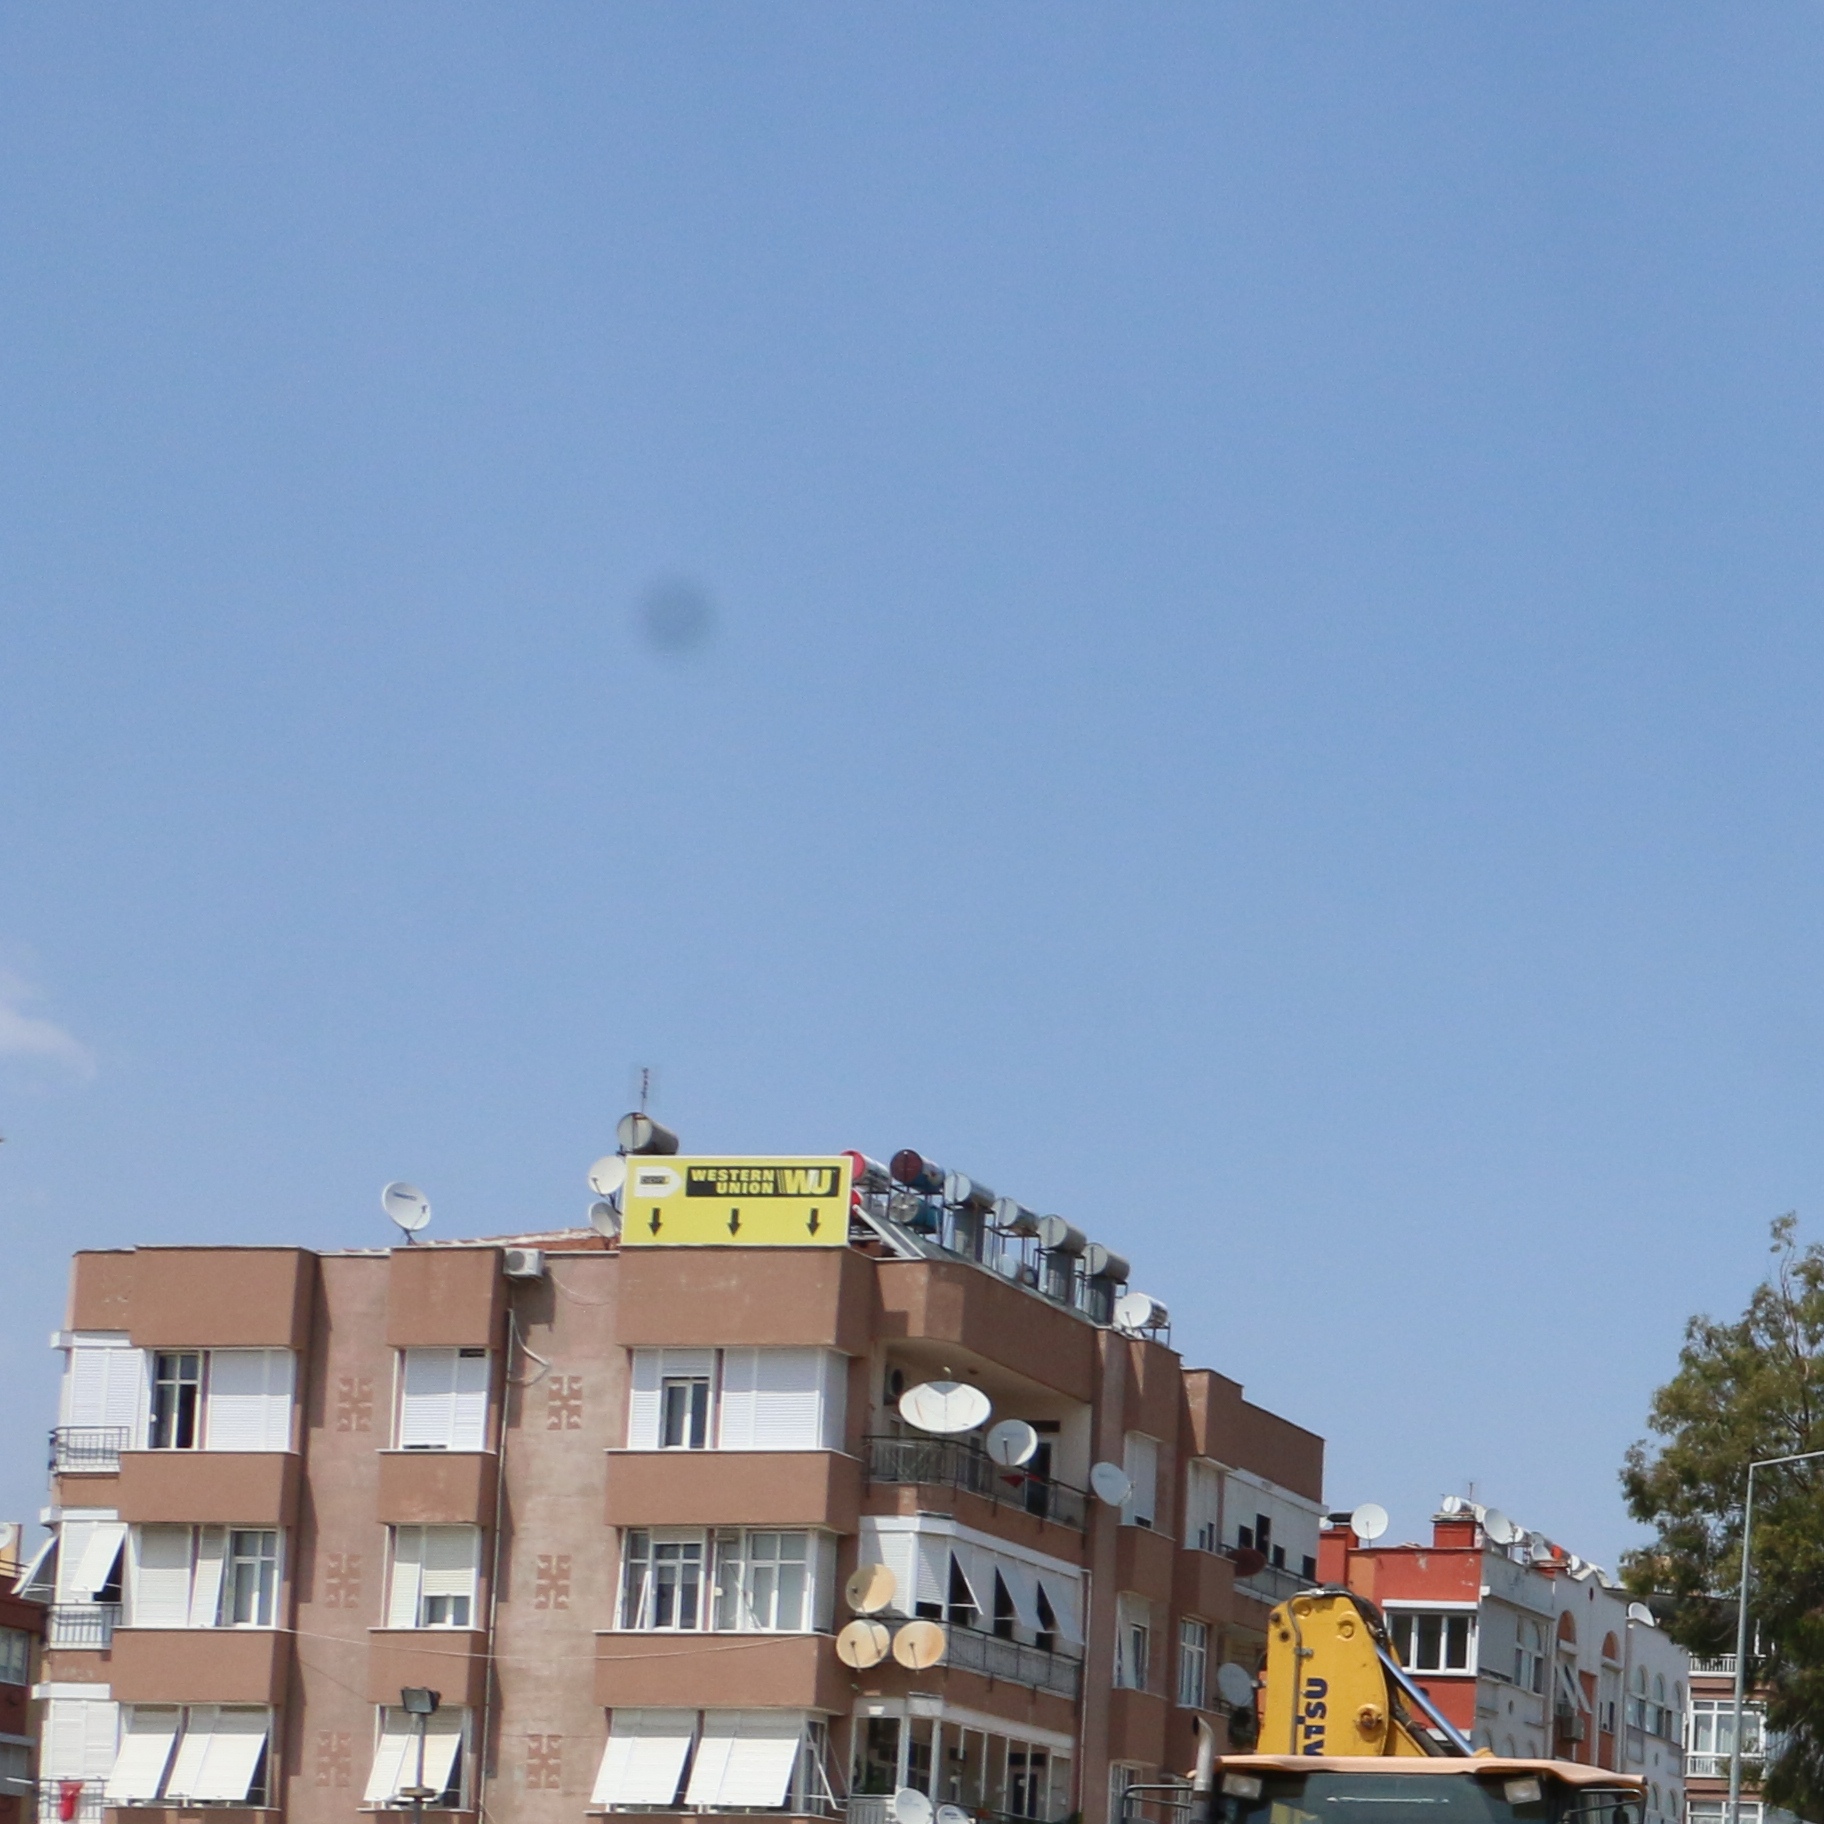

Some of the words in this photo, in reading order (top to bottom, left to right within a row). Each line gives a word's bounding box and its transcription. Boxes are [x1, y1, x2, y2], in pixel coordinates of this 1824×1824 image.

[691, 1169, 775, 1182] WESTERN
[784, 1169, 833, 1195] WU
[716, 1181, 774, 1194] UNION
